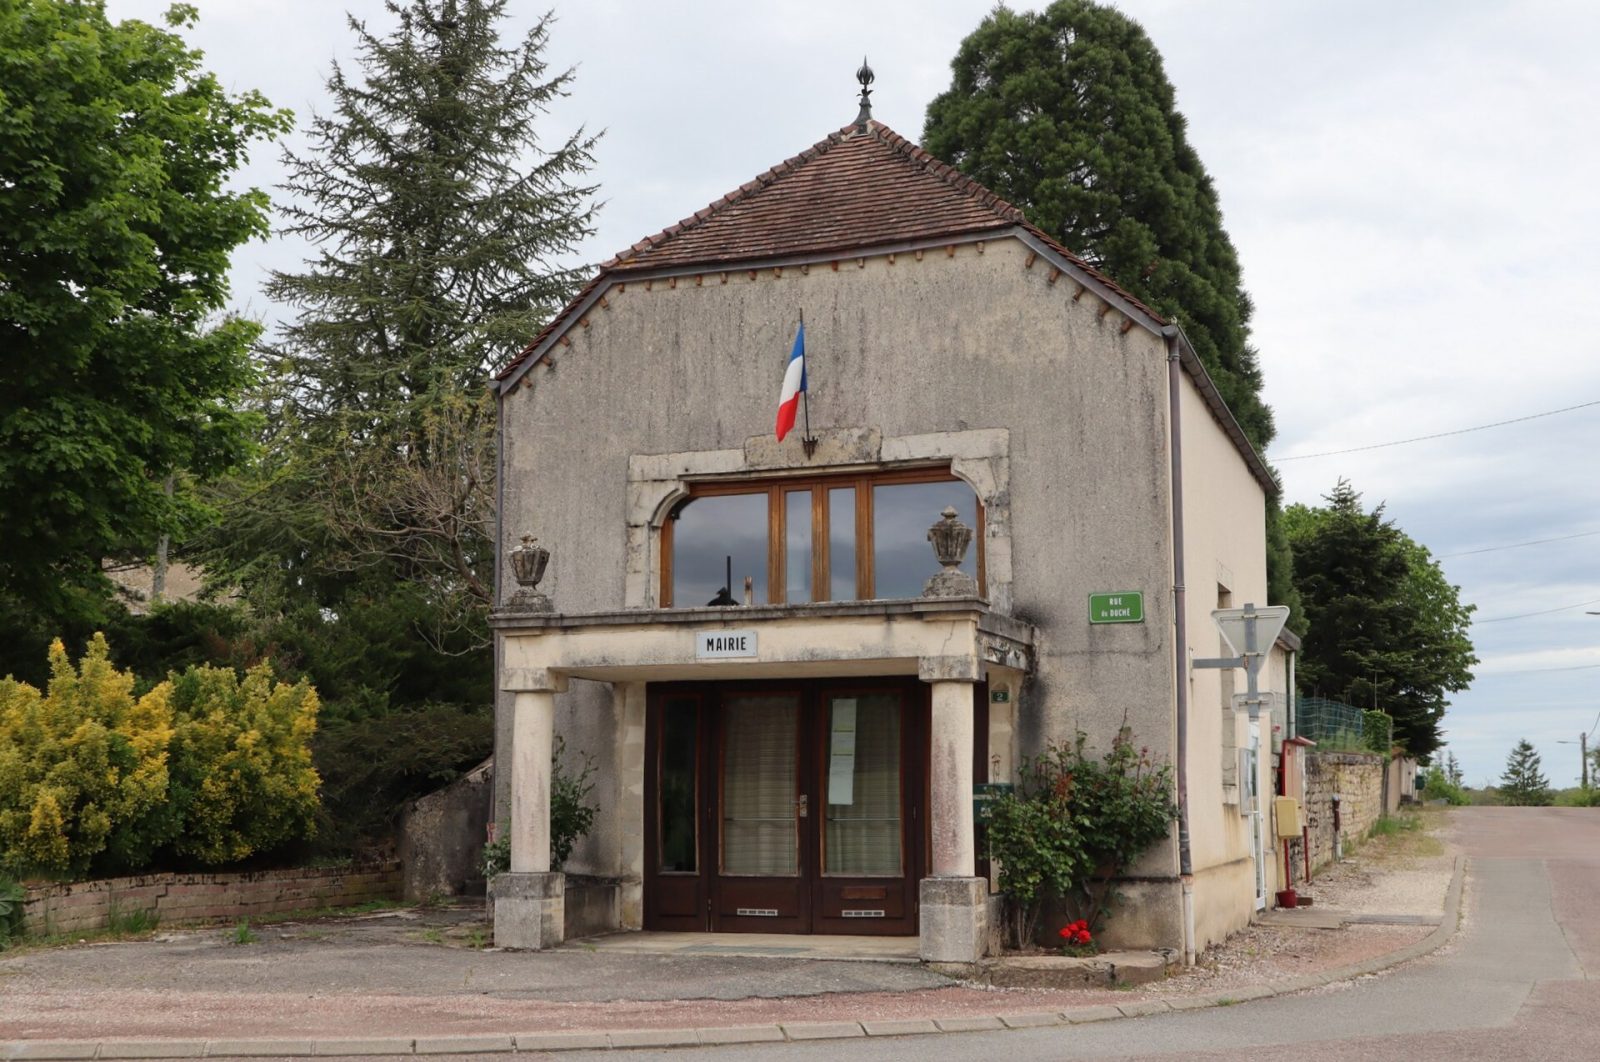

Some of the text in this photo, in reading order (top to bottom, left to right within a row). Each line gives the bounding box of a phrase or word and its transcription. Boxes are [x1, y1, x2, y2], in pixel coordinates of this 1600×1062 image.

[1109, 597, 1122, 605] RUE
[706, 636, 747, 652] MAIRIE
[996, 692, 1004, 701] 2
